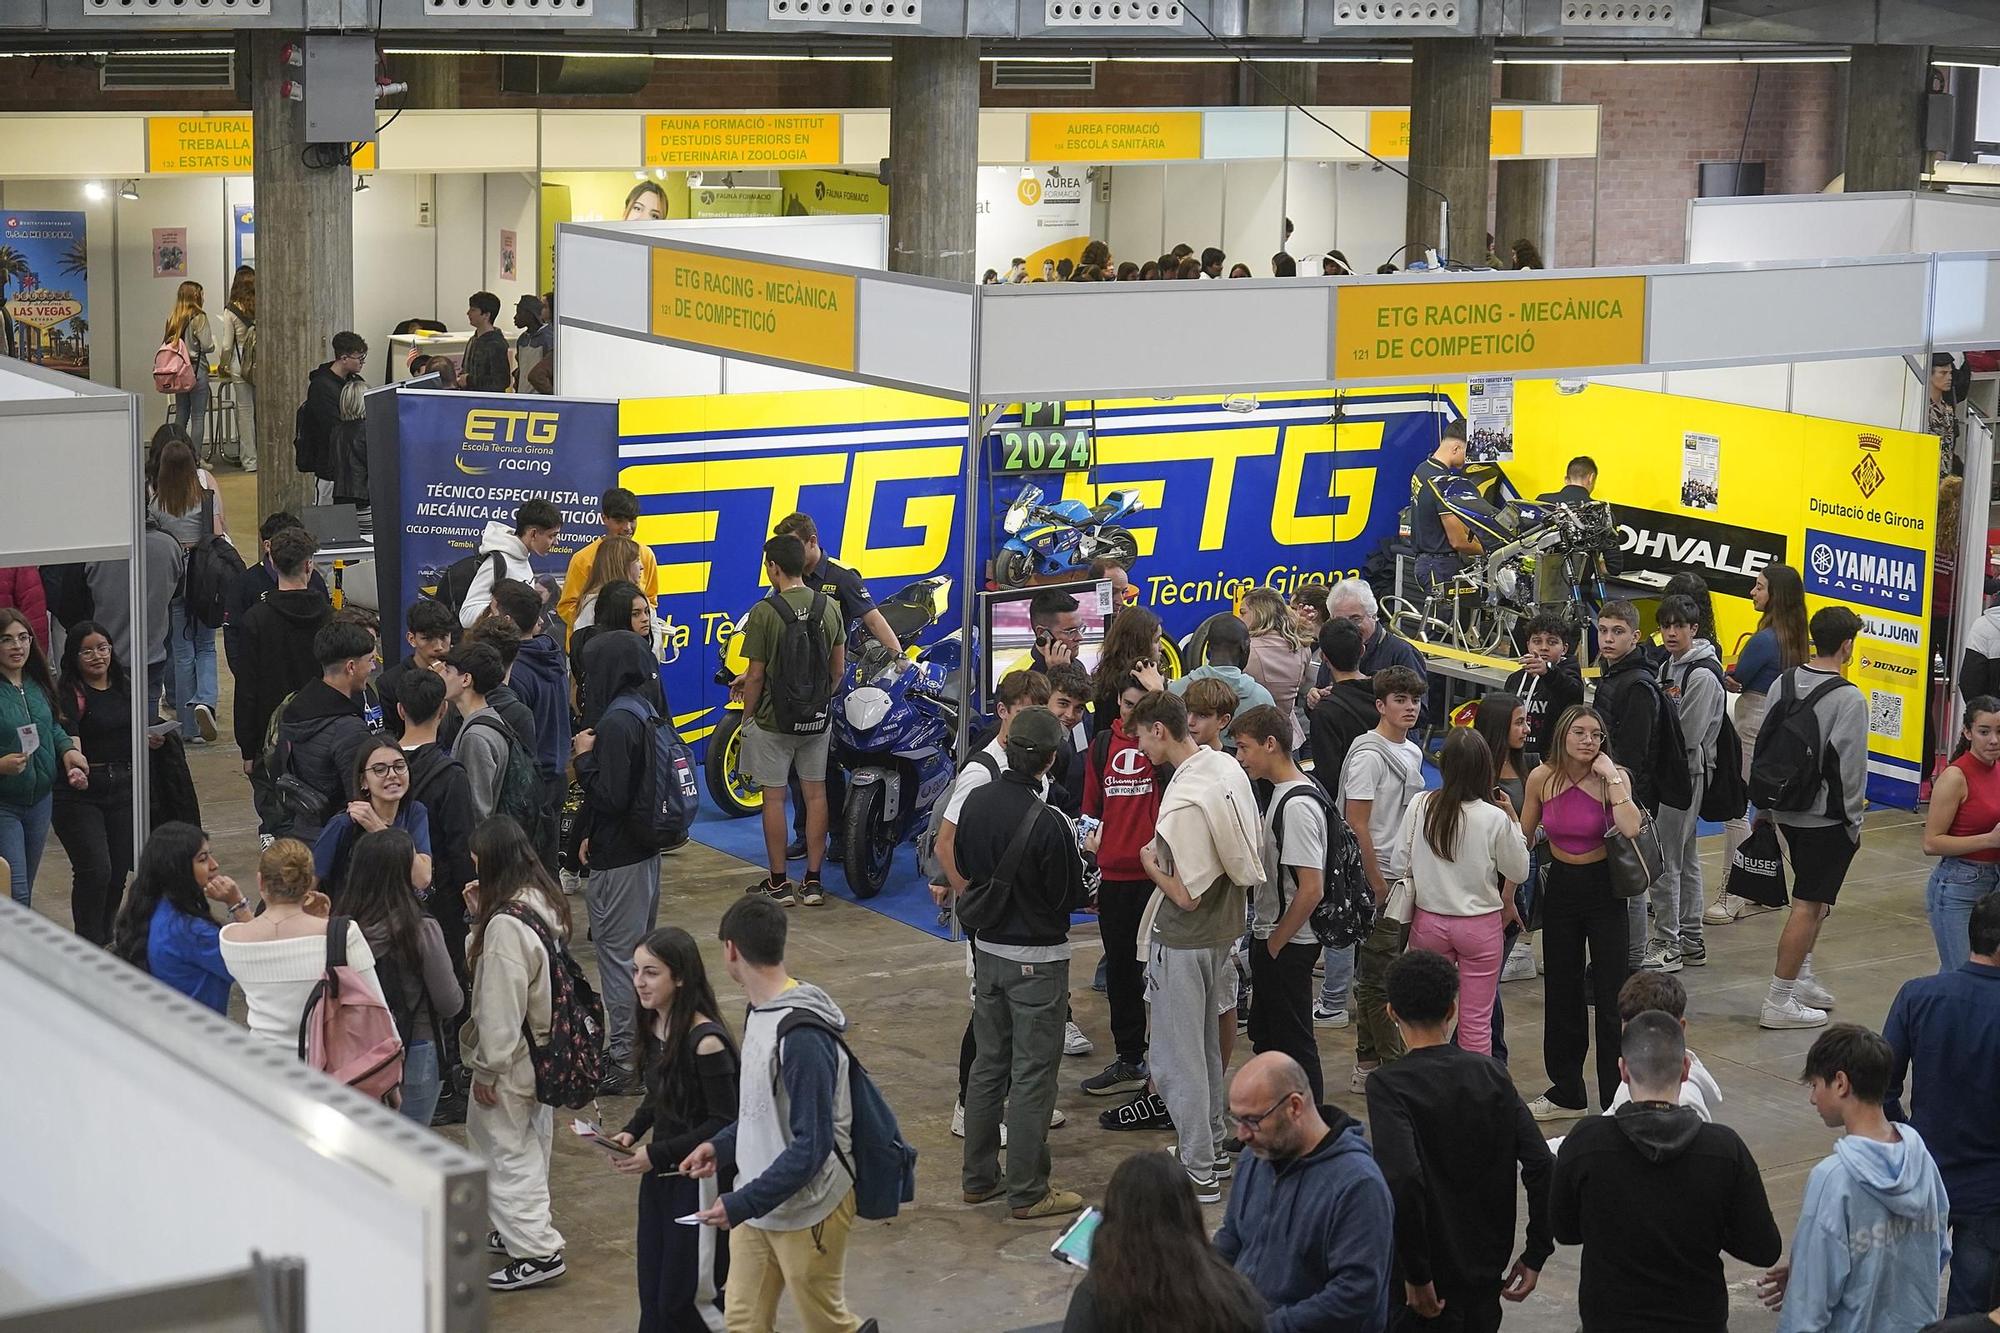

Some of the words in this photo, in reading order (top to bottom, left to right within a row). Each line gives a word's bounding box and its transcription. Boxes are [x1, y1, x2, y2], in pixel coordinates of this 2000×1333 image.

[178, 122, 250, 133] CULTURAL
[660, 119, 700, 130] FAUNA
[703, 116, 765, 129] FORMACIÓ
[774, 118, 824, 128] INSTITUT
[1067, 124, 1104, 134] AUREA
[1105, 122, 1160, 134] FORMACIÓ
[661, 135, 722, 146] D'ESTUDIS
[725, 134, 792, 145] SUPERIORS
[794, 134, 810, 144] EN
[1067, 139, 1110, 150] ESCOLA
[1111, 137, 1166, 149] SANITÀRIA
[179, 156, 230, 168] ESTATS
[661, 149, 739, 162] VETERINÀRIA
[741, 151, 744, 160] I
[748, 150, 808, 160] ZOOLOGIA
[1045, 178, 1080, 188] AUREA
[976, 200, 990, 214] at
[674, 267, 700, 289] ETG
[703, 272, 754, 298] RACING
[765, 280, 838, 312] MECÀNICA
[14, 306, 32, 316] LAS
[36, 306, 72, 316] VEGAS
[661, 304, 672, 315] 121
[674, 298, 692, 318] DE
[695, 300, 776, 334] COMPETICIÓ
[1377, 306, 1418, 328] ETG
[1425, 303, 1502, 326] RACING
[1520, 297, 1624, 322] MECÀNICA
[1353, 350, 1369, 361] 121
[1376, 338, 1404, 360] DE
[1410, 328, 1535, 358] COMPETICIÓ
[1024, 401, 1060, 426] P1
[464, 408, 560, 444] ETG
[462, 442, 489, 452] Escola
[491, 443, 522, 453] Tècnica
[524, 445, 554, 455] Girona
[1005, 432, 1088, 469] 2024
[498, 458, 551, 476] racing
[426, 482, 486, 500] TÉCNICO
[488, 486, 580, 505] ESPECIALISTA
[582, 494, 598, 506] en
[416, 502, 489, 518] MECÁNICA
[492, 508, 508, 520] de
[1810, 497, 1864, 522] Diputació
[1866, 507, 1882, 524] de
[1884, 512, 1924, 530] Girona
[406, 524, 430, 534] CICLO
[430, 526, 480, 536] FORMATIVO
[618, 446, 964, 596] ETG
[1836, 549, 1917, 592] YAMAHA
[1147, 568, 1254, 607] Tècnica
[1818, 576, 1910, 602] RACING
[1878, 623, 1918, 645] J.JUAN
[1873, 660, 1918, 676] DUNLOP
[1104, 776, 1152, 786] Champion
[1744, 856, 1776, 870] EUSES
